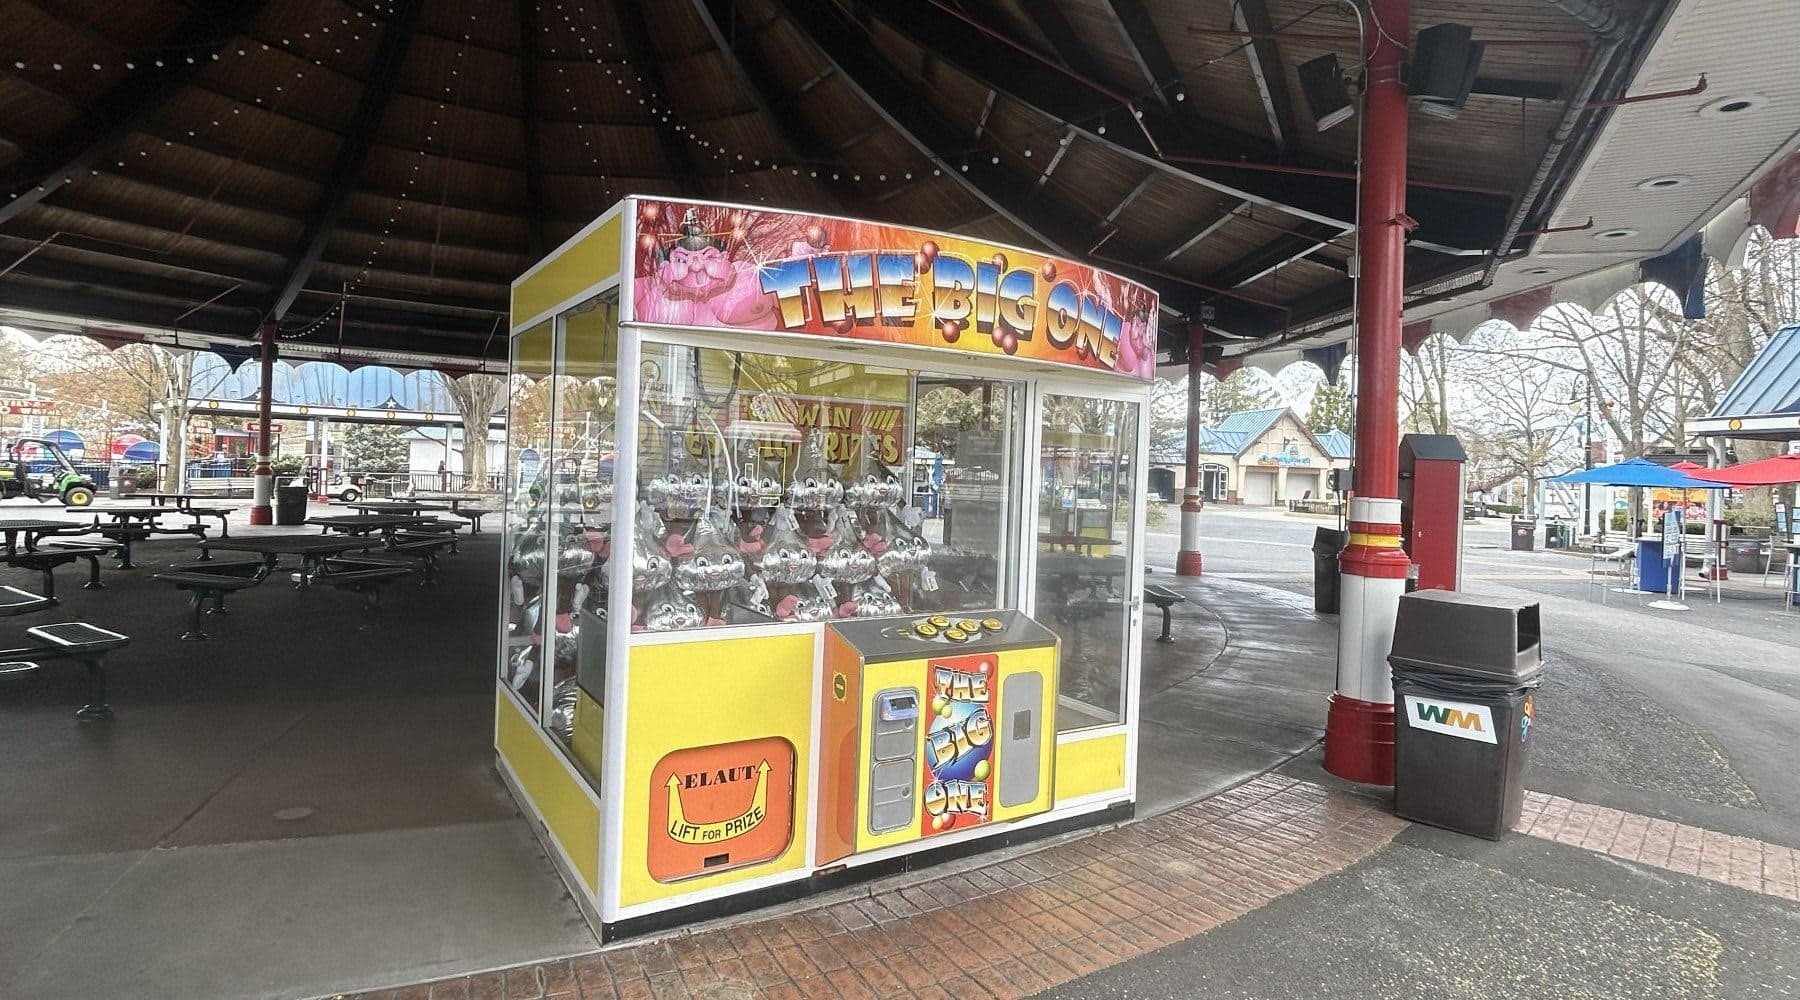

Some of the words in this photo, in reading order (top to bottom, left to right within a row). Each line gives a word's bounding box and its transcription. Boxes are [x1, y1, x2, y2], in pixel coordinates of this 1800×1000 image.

[759, 250, 918, 328] THE
[932, 253, 1038, 341] BIG
[1046, 281, 1126, 369] ONE
[797, 403, 853, 429] WIN
[933, 664, 990, 703] THE
[1416, 702, 1483, 732] WM
[926, 708, 993, 773] BIG
[684, 765, 756, 790] ELAUT
[924, 779, 989, 817] ONE
[670, 820, 700, 841] LIFT
[702, 829, 722, 841] FOR
[725, 806, 764, 837] PRIZE
